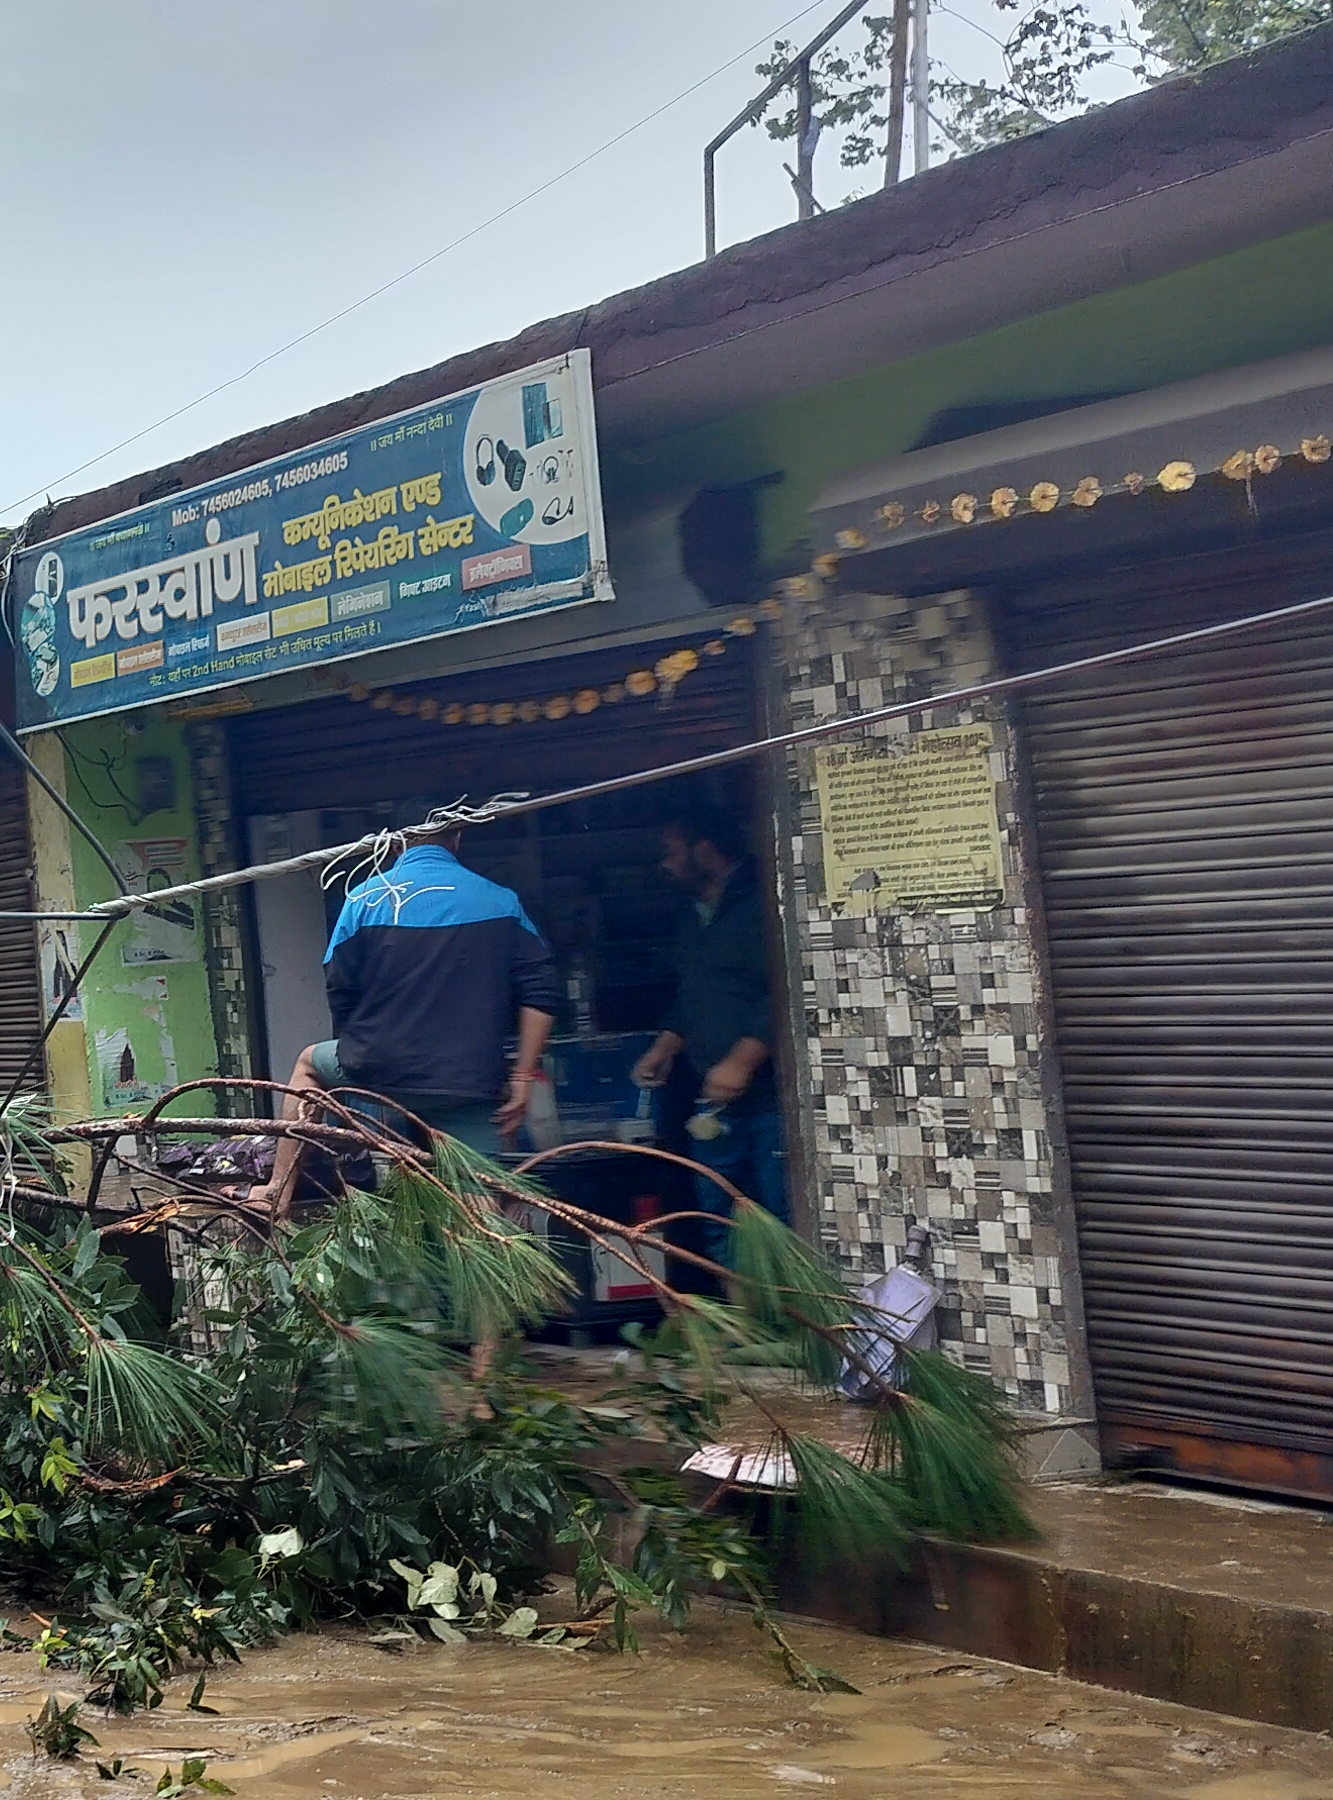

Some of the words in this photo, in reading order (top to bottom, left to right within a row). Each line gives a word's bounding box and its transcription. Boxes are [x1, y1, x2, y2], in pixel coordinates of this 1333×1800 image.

[378, 434, 393, 448] जय
[406, 421, 427, 439] नन्दा
[428, 412, 444, 431] देवी
[172, 506, 200, 527] Mob:
[202, 478, 273, 517] 7456024605,
[274, 451, 349, 493] 7456034605
[282, 487, 398, 550] कम्यूनिकेशन
[399, 472, 442, 513] एण्ड
[262, 554, 332, 598] मोबाइल
[333, 525, 415, 579] रिपेयरिंग
[417, 513, 475, 557] सेन्टर
[192, 663, 210, 678] 2nd
[211, 656, 235, 672] Hand
[236, 649, 263, 667] मोबाइल
[280, 640, 290, 655] भी
[291, 635, 312, 655] उचित
[332, 631, 343, 645] पर
[344, 620, 367, 642] मिलते
